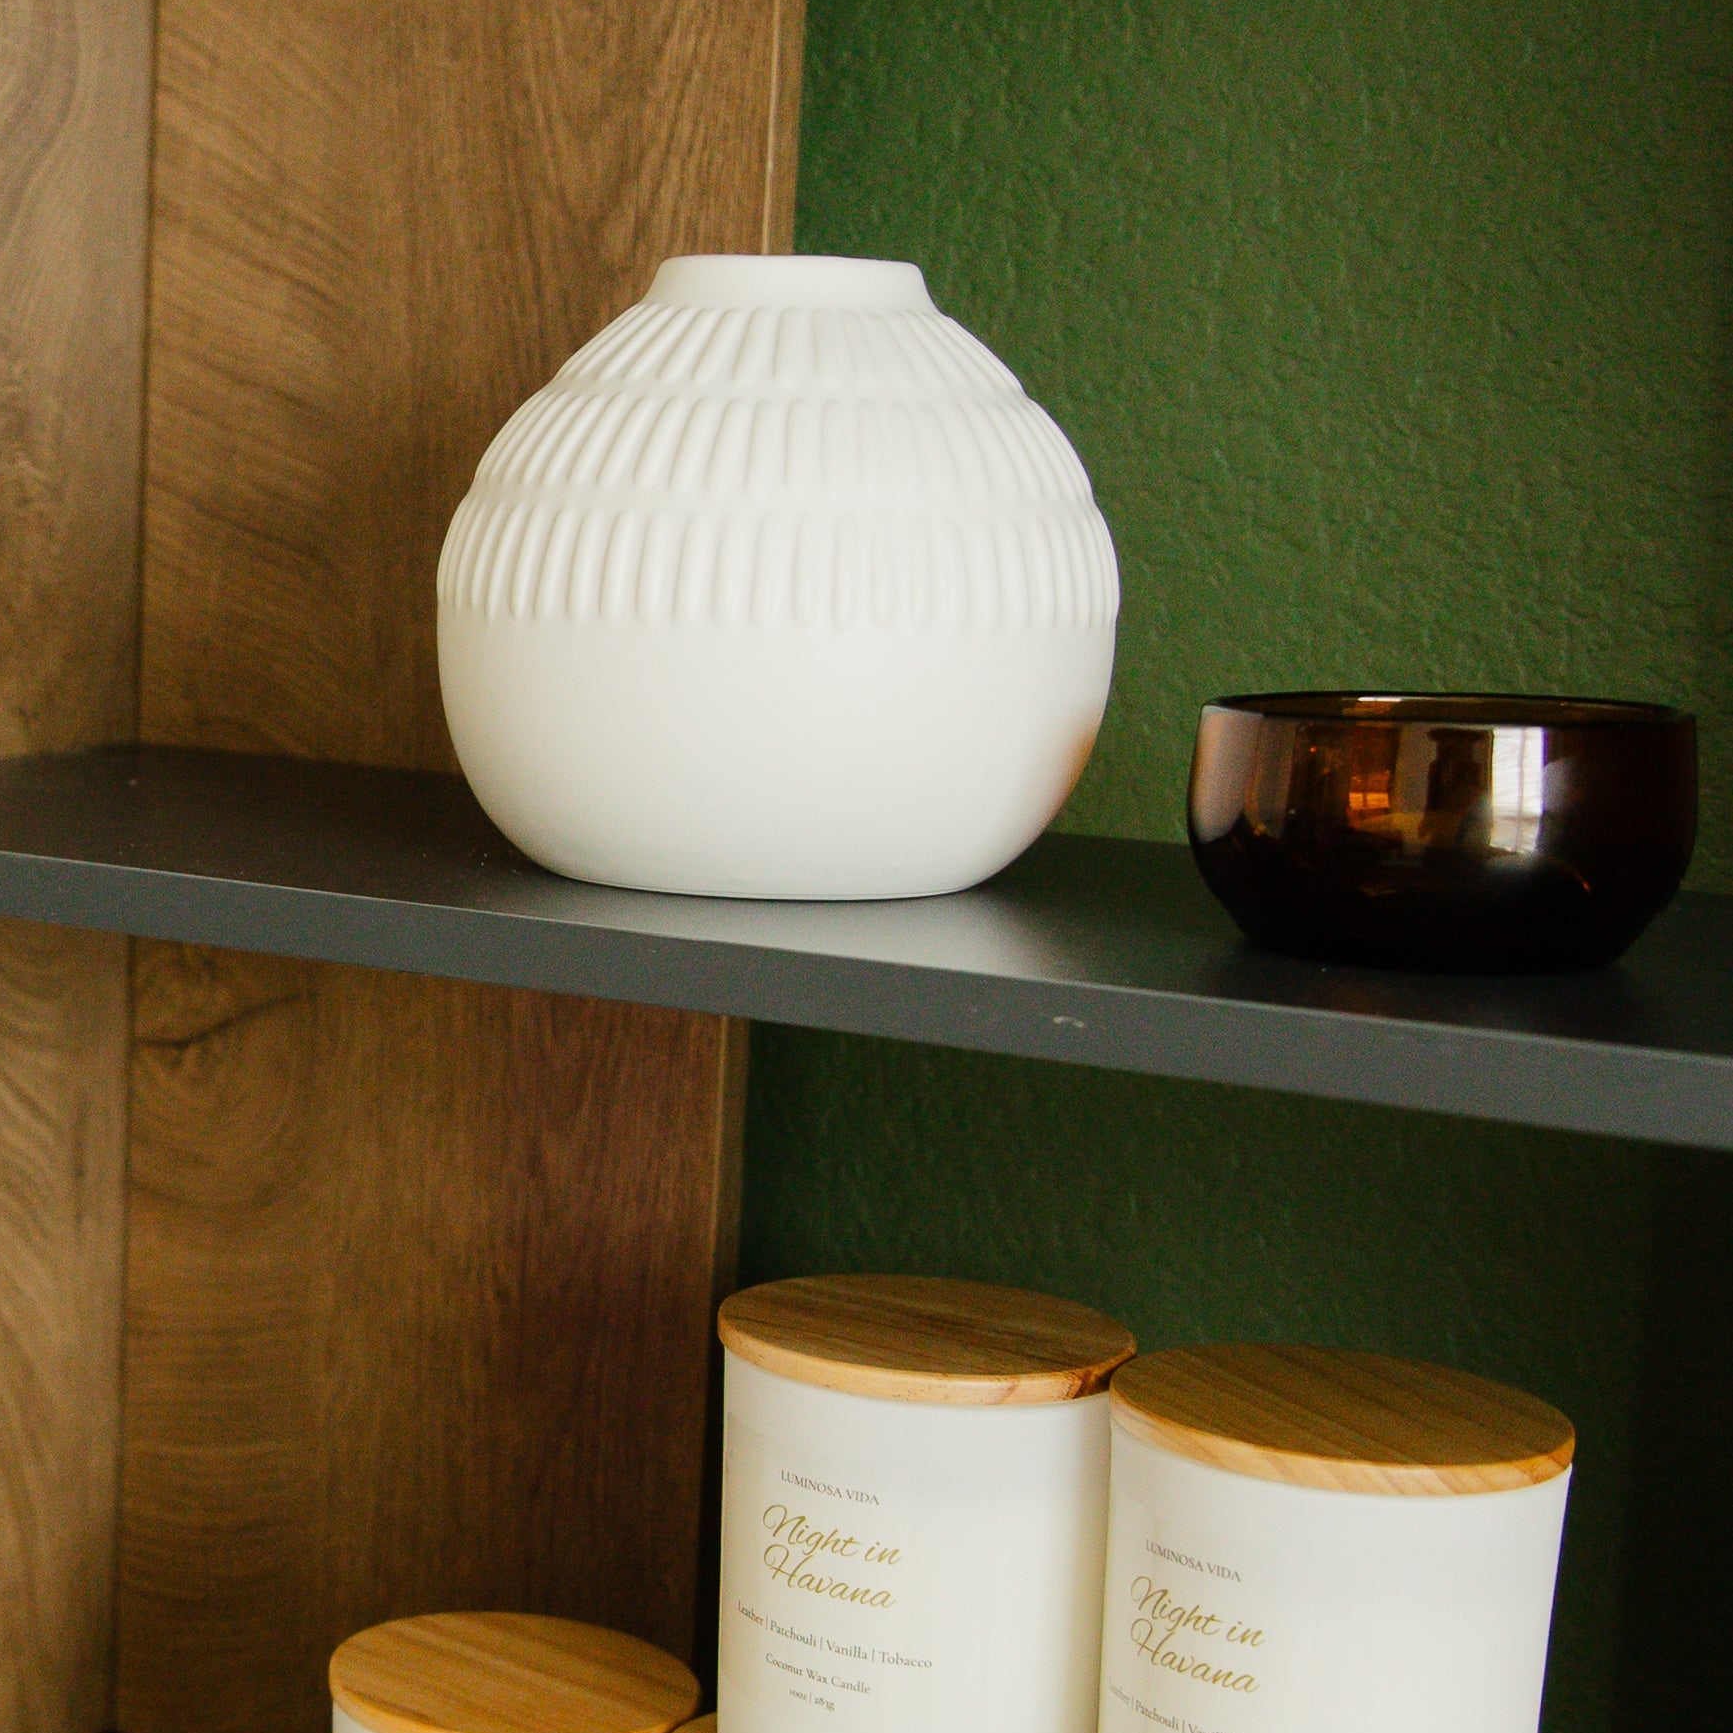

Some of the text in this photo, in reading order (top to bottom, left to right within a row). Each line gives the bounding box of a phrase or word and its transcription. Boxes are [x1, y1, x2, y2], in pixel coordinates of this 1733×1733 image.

[781, 1470, 879, 1505] LUMINOSA VIDA
[762, 1504, 902, 1566] Night in
[762, 1543, 896, 1609] Havana
[1145, 1539, 1242, 1582] LUMINOSA VIDA
[1130, 1576, 1266, 1648] Night in
[770, 1620, 817, 1648] Patchouli
[826, 1639, 868, 1660] Vanilla
[879, 1651, 933, 1668] Tobacco
[1130, 1618, 1260, 1693] Havana
[765, 1653, 870, 1694] Coconut Wax Candle
[1135, 1699, 1179, 1731] Patchouli
